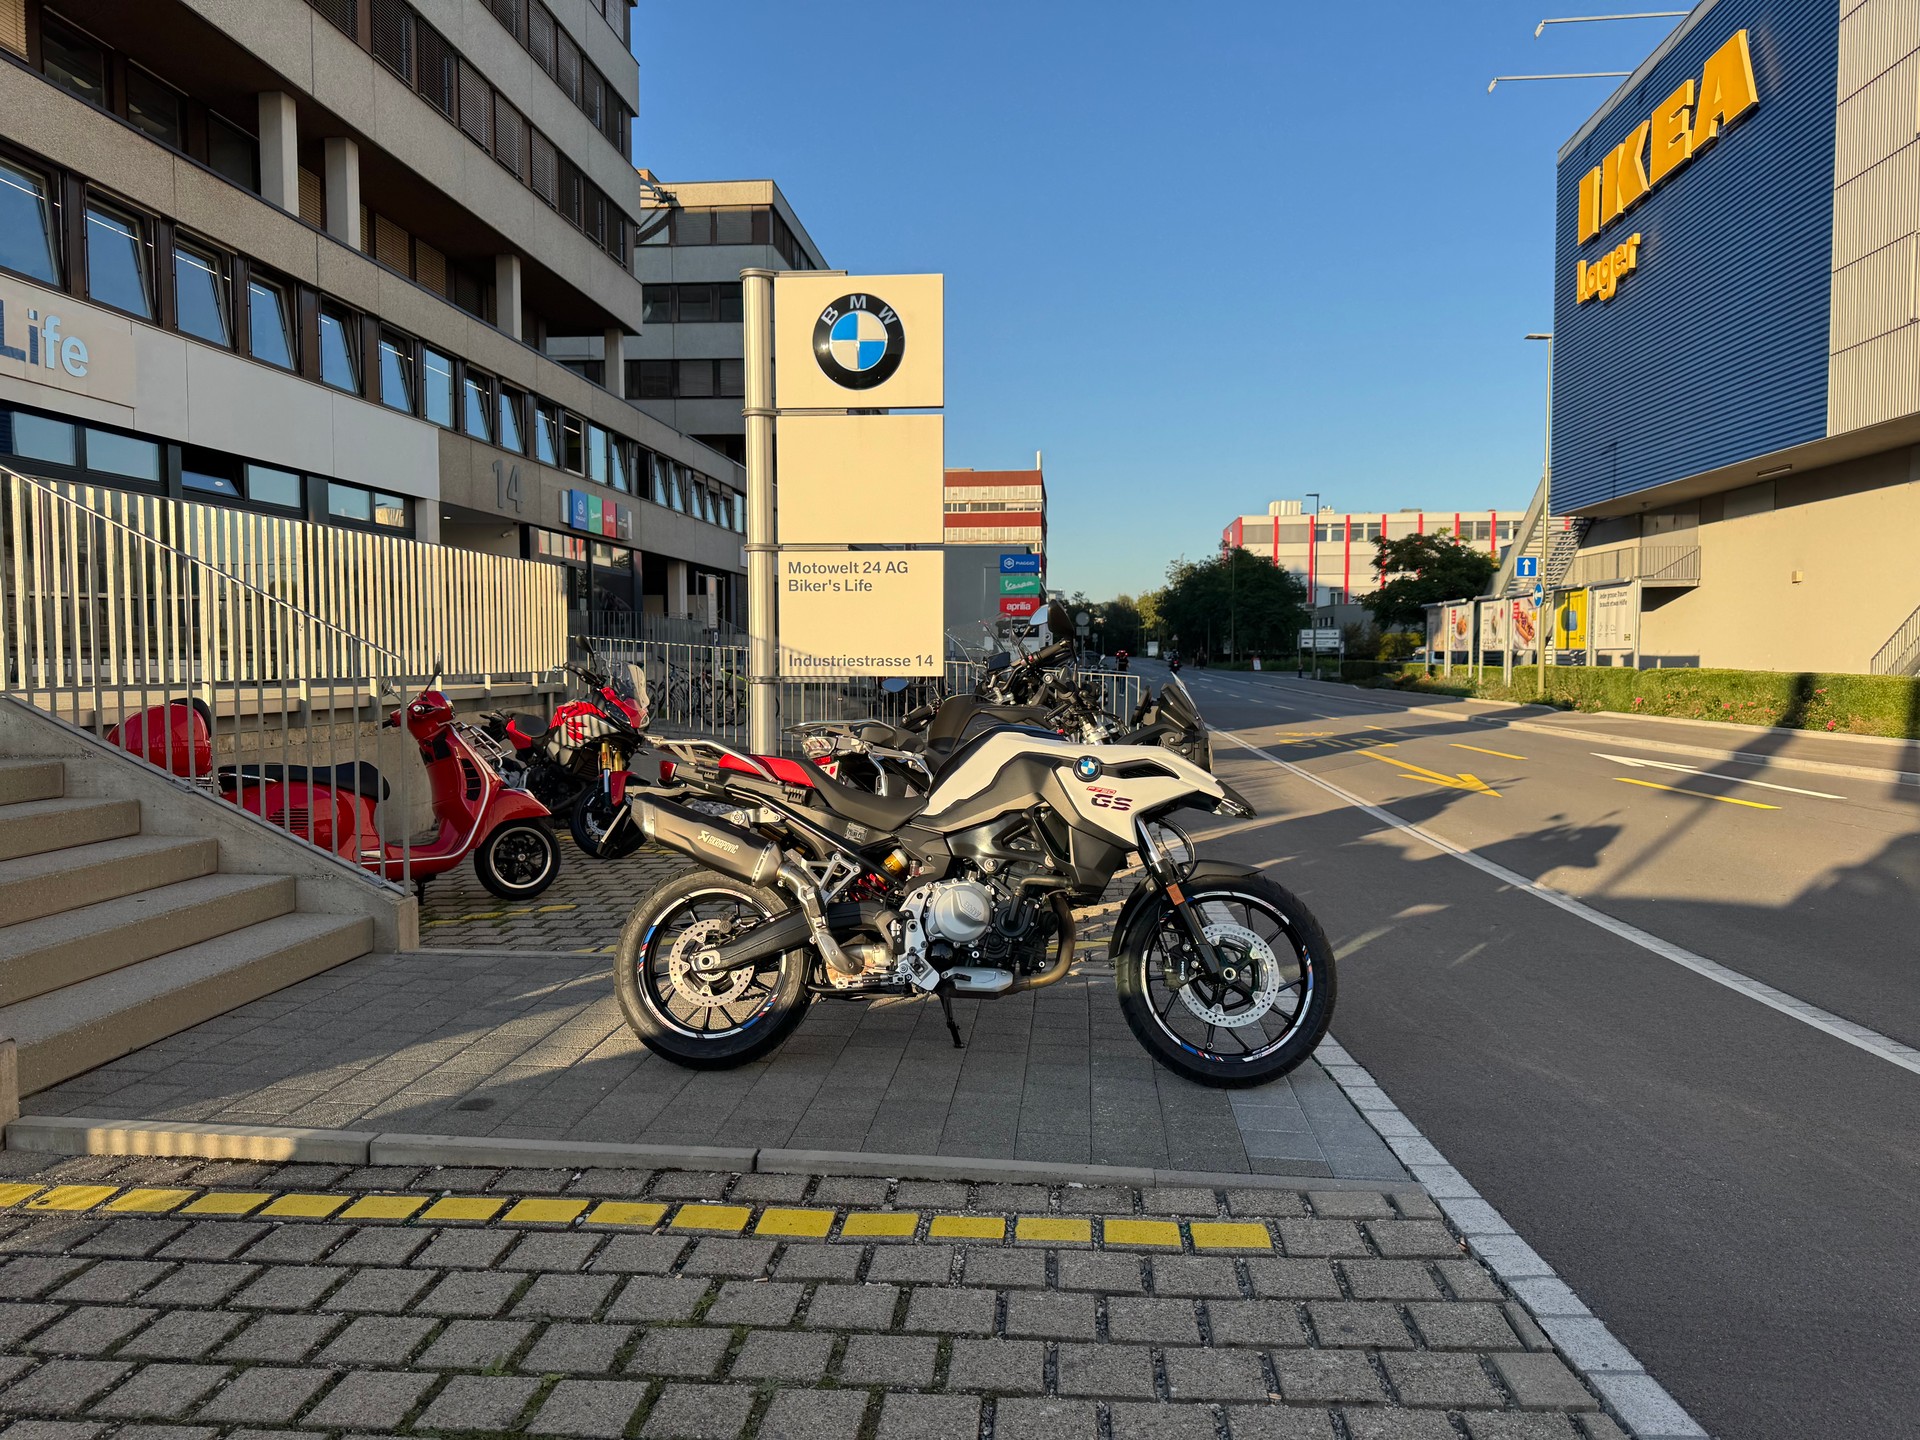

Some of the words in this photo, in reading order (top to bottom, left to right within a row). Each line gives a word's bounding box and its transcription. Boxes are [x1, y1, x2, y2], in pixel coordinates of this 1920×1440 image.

[1577, 29, 1759, 246] IKEA
[1576, 233, 1641, 305] Lager
[820, 295, 898, 326] BMW
[0, 298, 89, 378] Life
[492, 459, 523, 513] 14
[788, 561, 859, 574] Motowelt
[862, 561, 881, 574] 24
[885, 561, 909, 574] AG
[788, 579, 841, 592] Biker's
[844, 579, 873, 592] Life
[1006, 602, 1031, 611] aprilia
[789, 654, 911, 667] Industriestrasse
[915, 654, 934, 667] 14
[1091, 793, 1133, 811] GS
